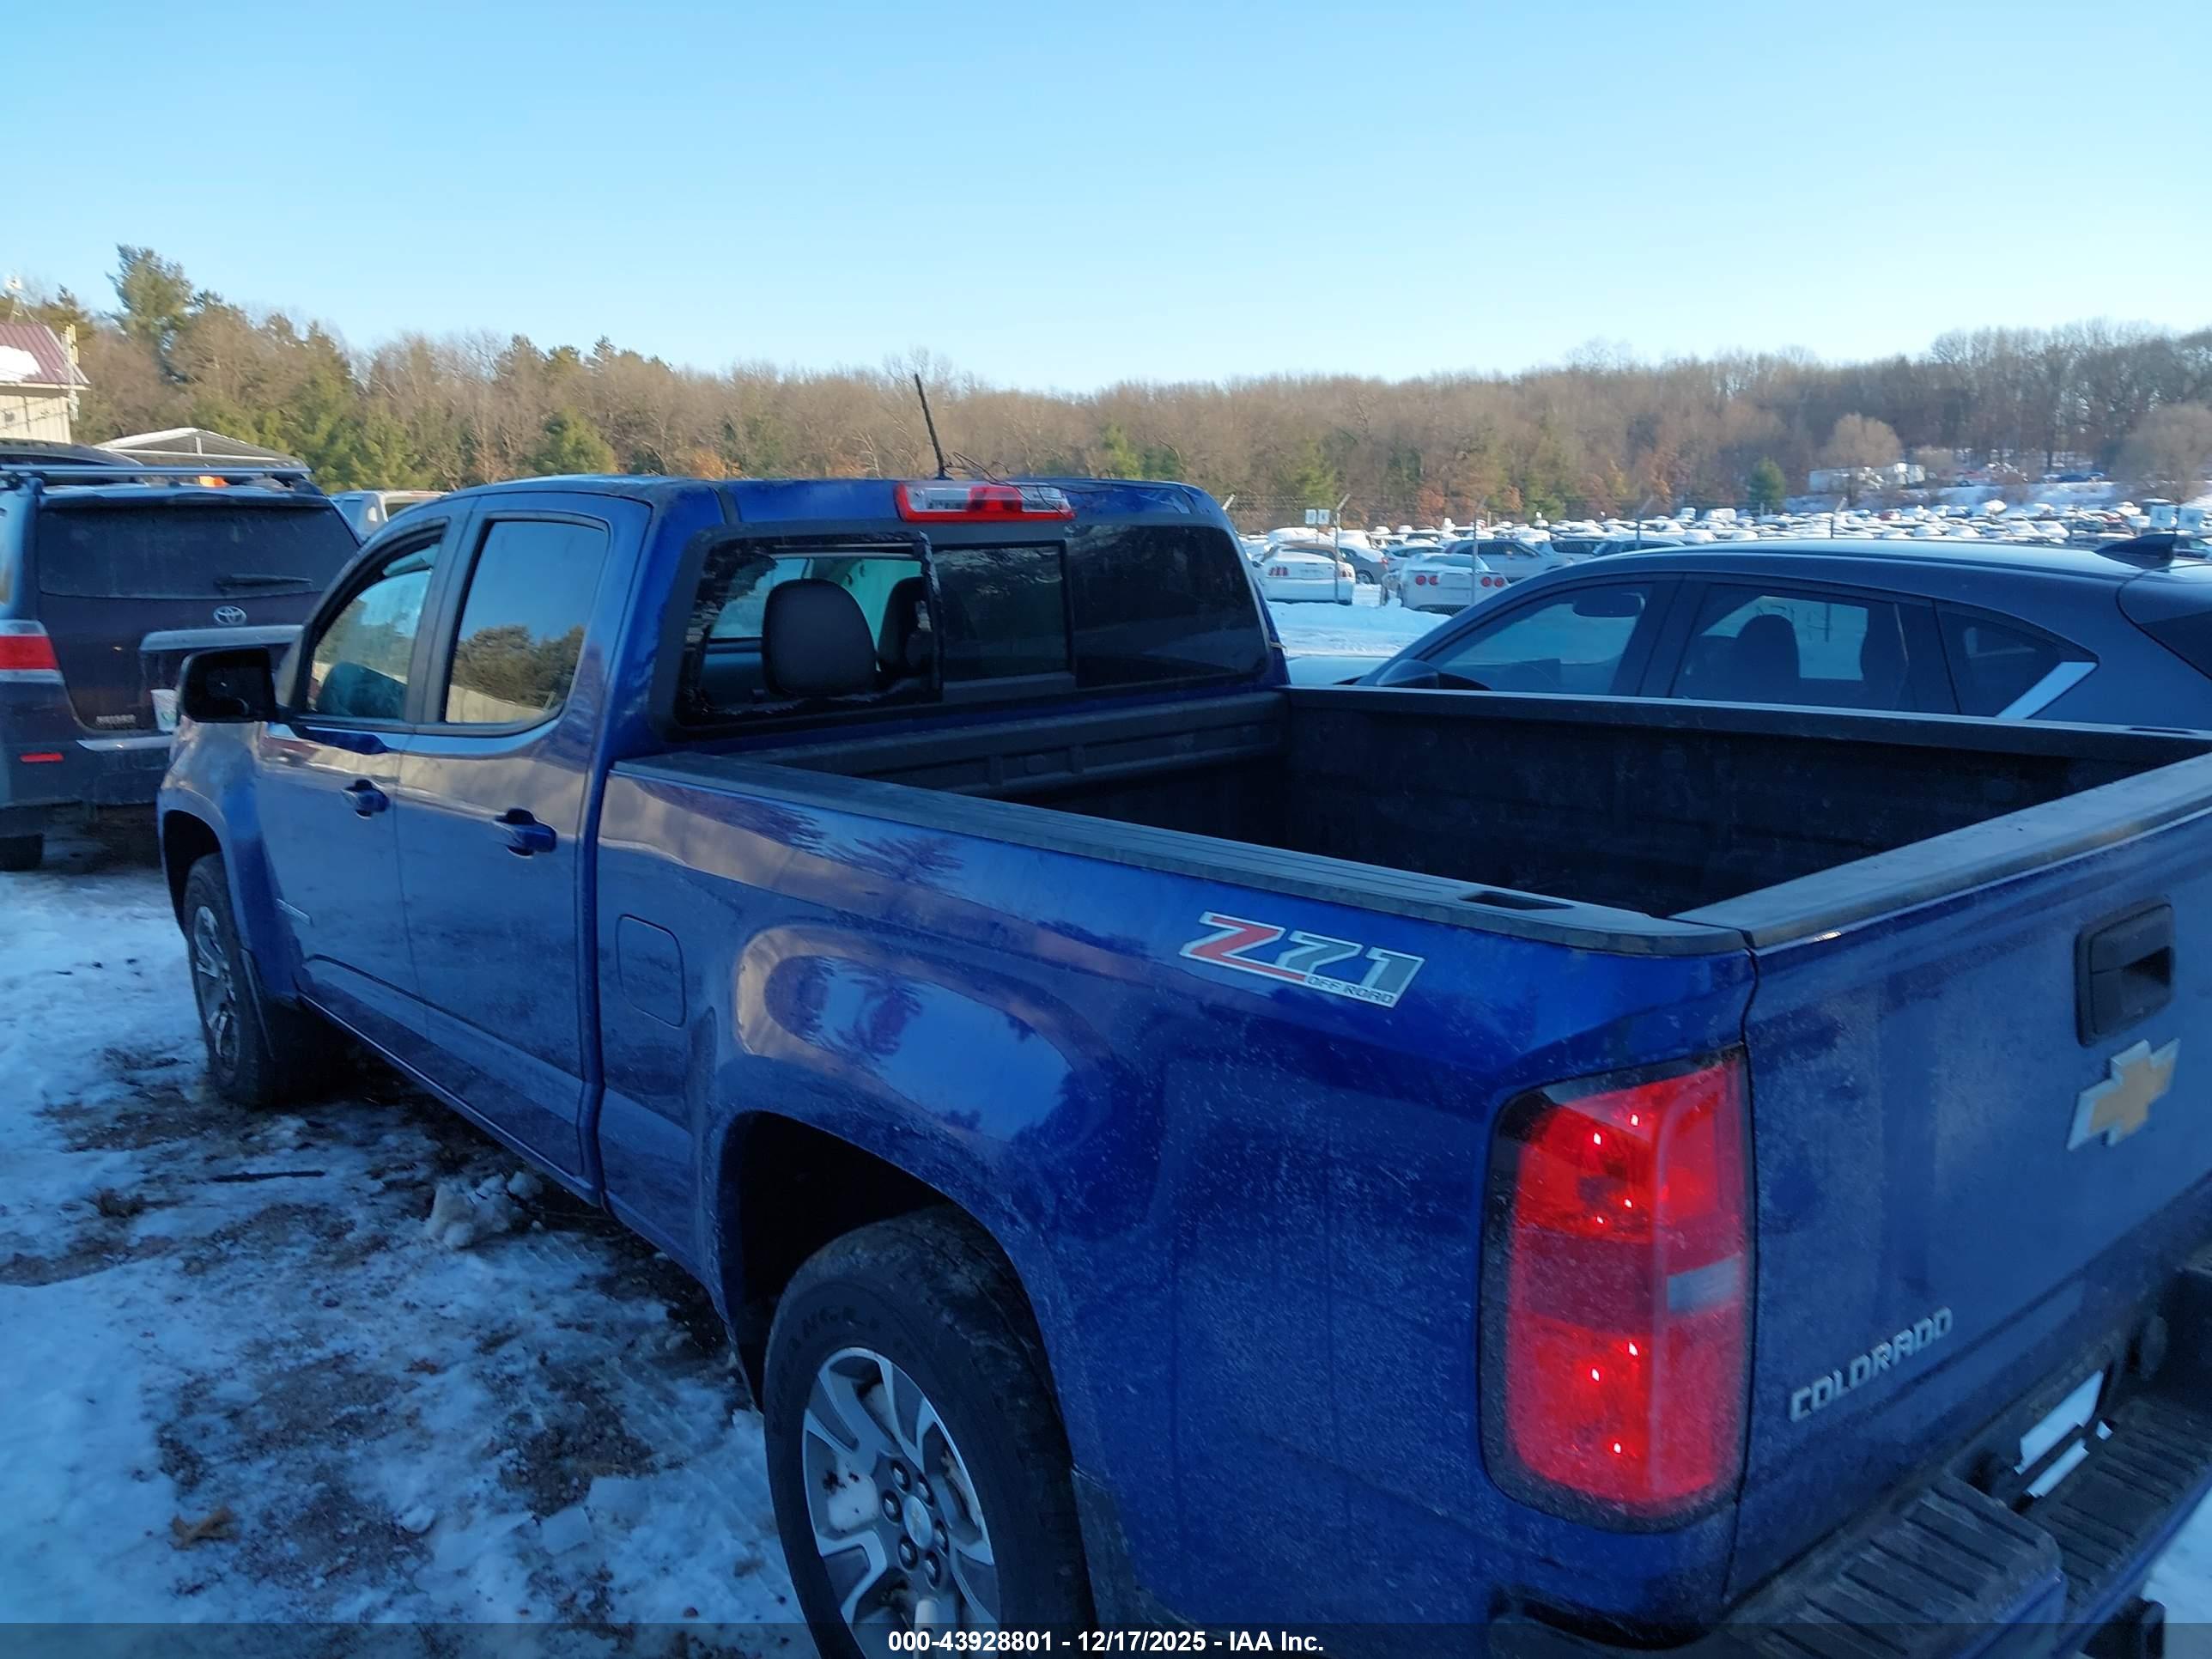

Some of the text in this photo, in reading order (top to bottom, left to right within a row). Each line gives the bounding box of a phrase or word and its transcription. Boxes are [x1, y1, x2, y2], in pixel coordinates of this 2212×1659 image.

[1179, 911, 1425, 1007] Z71
[1306, 975, 1395, 1005] OFF ROAD
[1790, 1305, 1954, 1422] COLORADO
